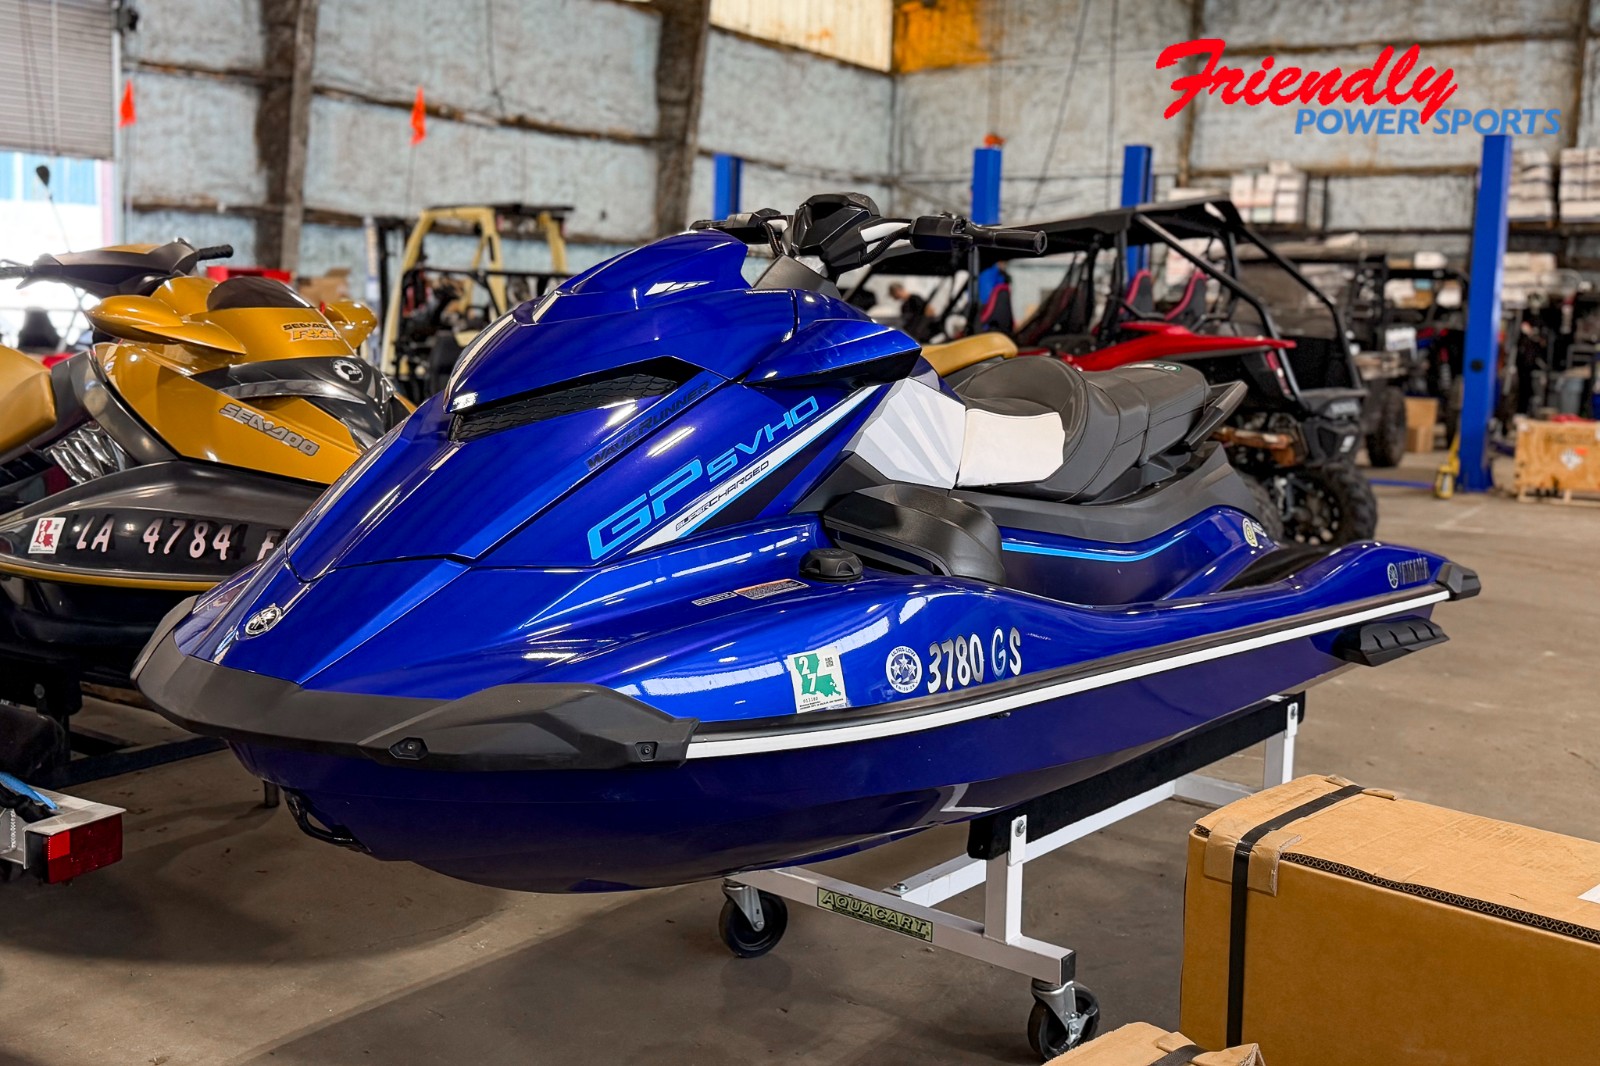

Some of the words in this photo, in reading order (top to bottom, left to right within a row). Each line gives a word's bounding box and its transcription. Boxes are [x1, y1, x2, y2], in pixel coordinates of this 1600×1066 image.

[587, 381, 709, 469] WAVERUNNER
[587, 458, 703, 560] GP
[706, 395, 819, 483] SVHO
[675, 460, 770, 532] SUPERCHARGED
[76, 516, 115, 553] LA
[142, 518, 232, 561] 4784
[798, 656, 811, 676] 2
[806, 672, 817, 693] 7
[927, 633, 984, 694] 3780
[821, 891, 927, 932] AQUACART
